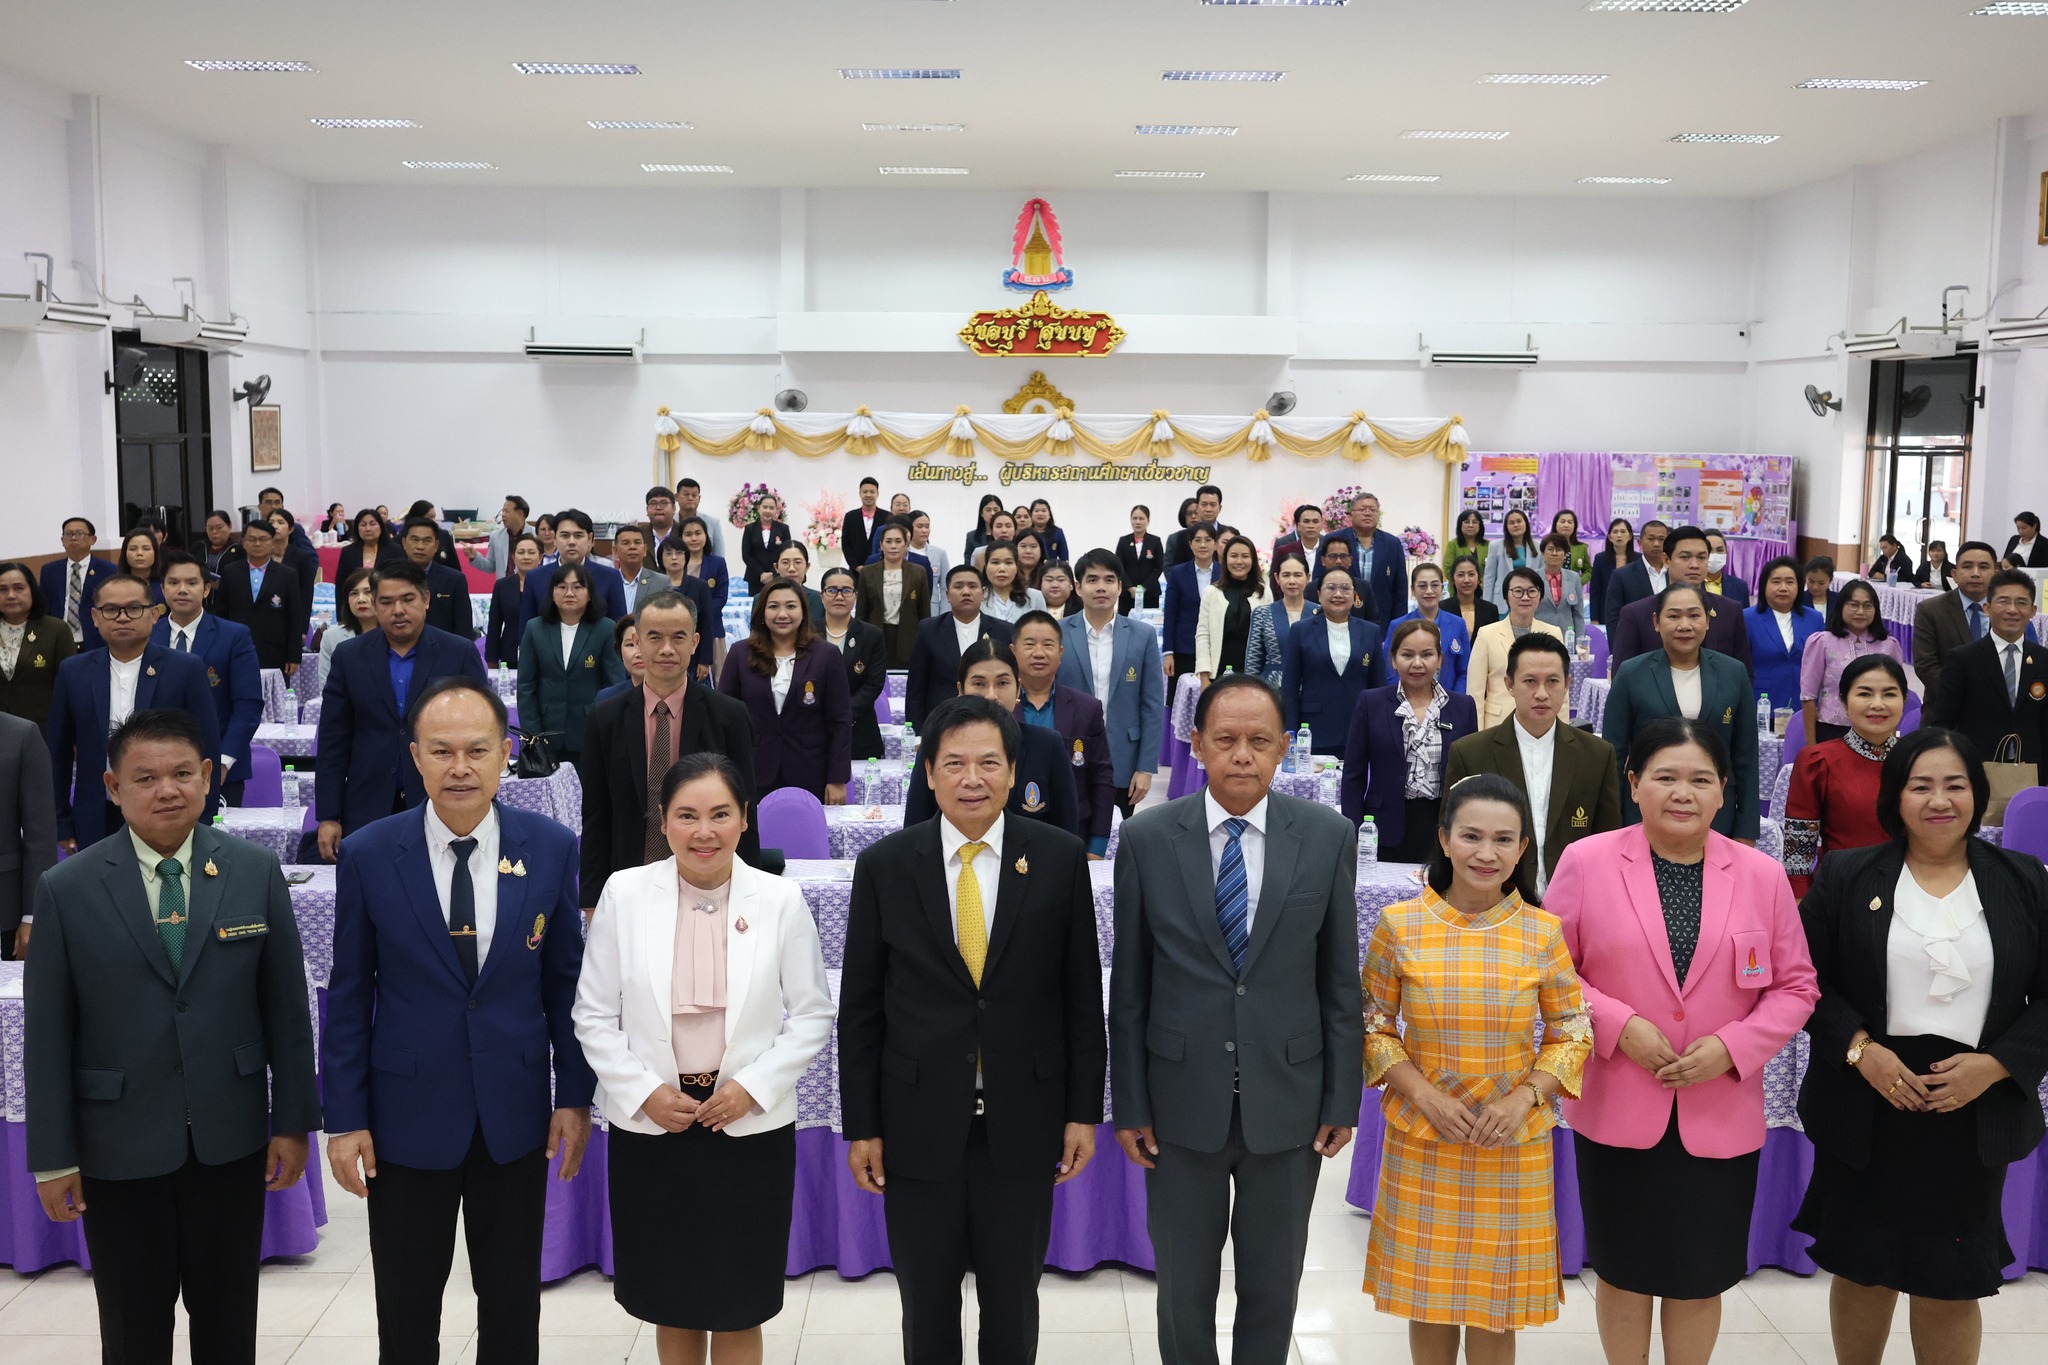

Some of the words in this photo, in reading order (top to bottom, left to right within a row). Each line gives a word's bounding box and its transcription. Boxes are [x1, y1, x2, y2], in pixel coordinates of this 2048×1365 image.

[974, 318, 1031, 350] ชลบุรี
[908, 460, 988, 486] เส้นทางสู่...
[999, 459, 1211, 487] ผู้บริหารสถานศึกษาเชี่ยวชาญ
